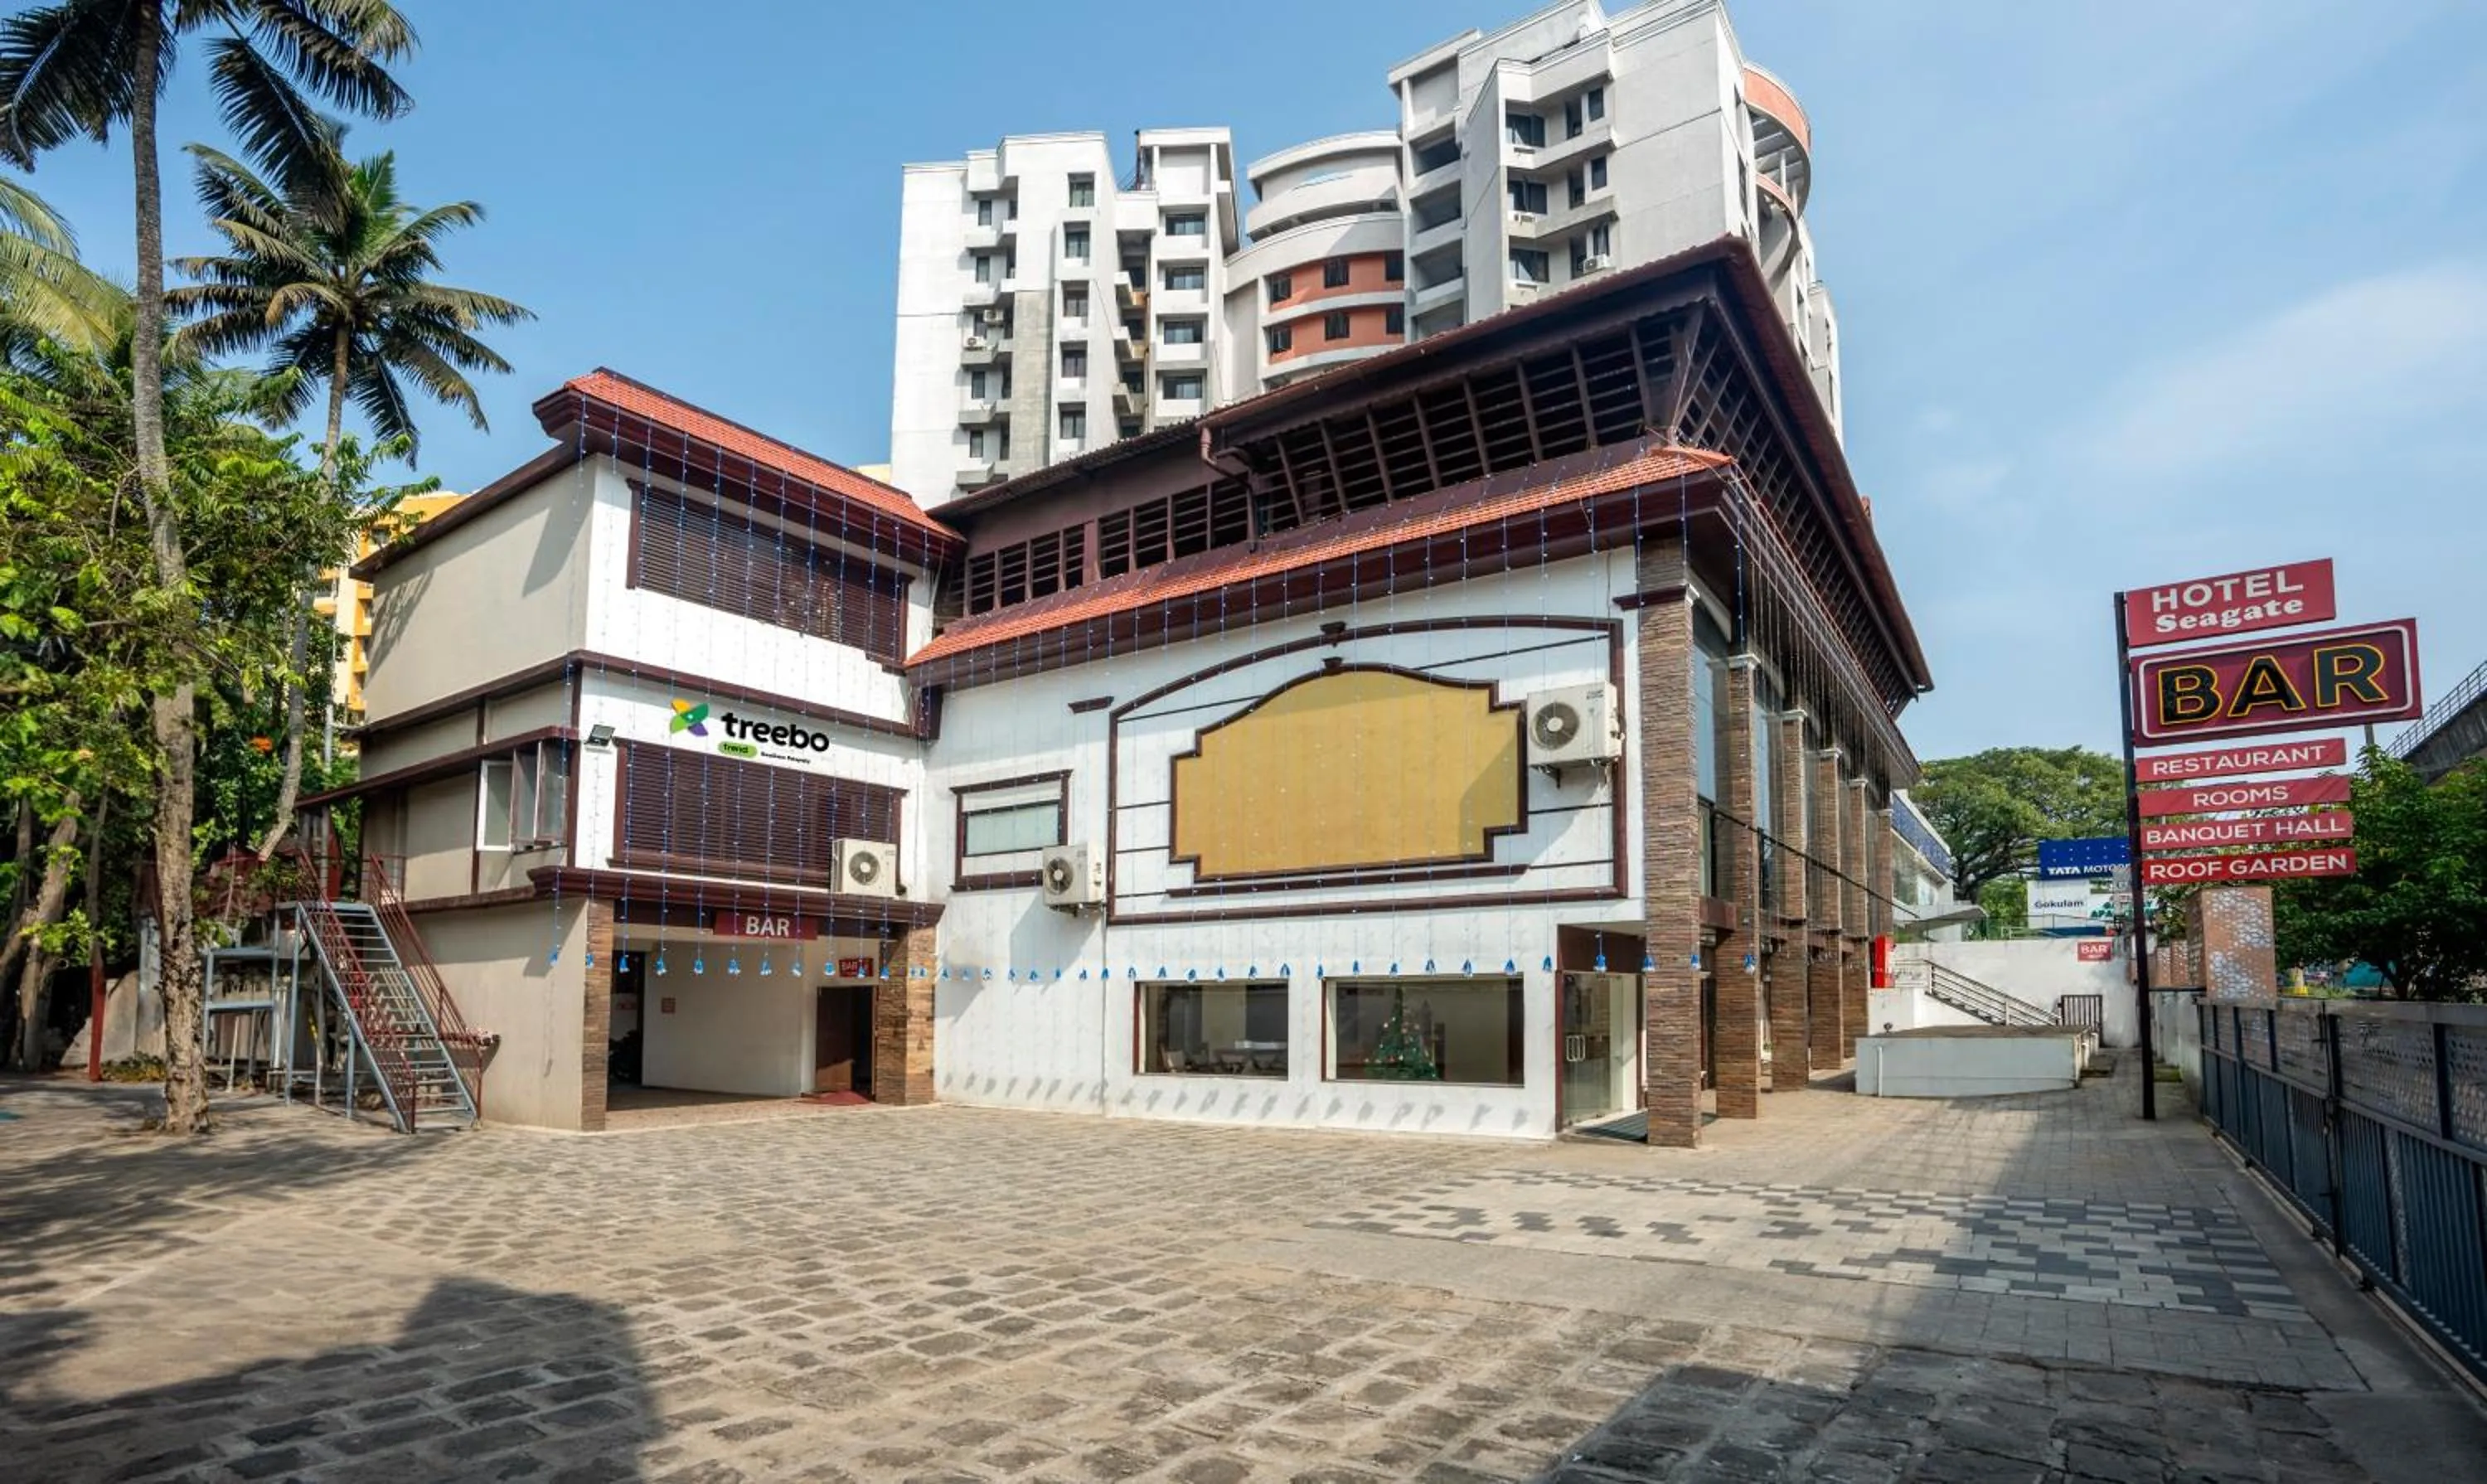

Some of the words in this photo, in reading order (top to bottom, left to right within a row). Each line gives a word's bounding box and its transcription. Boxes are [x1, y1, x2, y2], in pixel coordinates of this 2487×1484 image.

[2151, 570, 2304, 613] HOTEL
[2155, 597, 2305, 633] Seagate
[2158, 643, 2389, 726] BAR
[720, 711, 830, 752] treebo
[2153, 745, 2326, 776] RESTAURANT
[2193, 785, 2289, 807] ROOMS
[2146, 822, 2266, 845] BANQUET
[2276, 818, 2345, 837] HALL
[2048, 866, 2081, 875] TATA
[2150, 861, 2223, 879] ROOF
[2229, 854, 2347, 875] GARDEN
[2034, 899, 2084, 909] Gokulam
[745, 915, 790, 937] BAR
[2081, 944, 2108, 954] BAR
